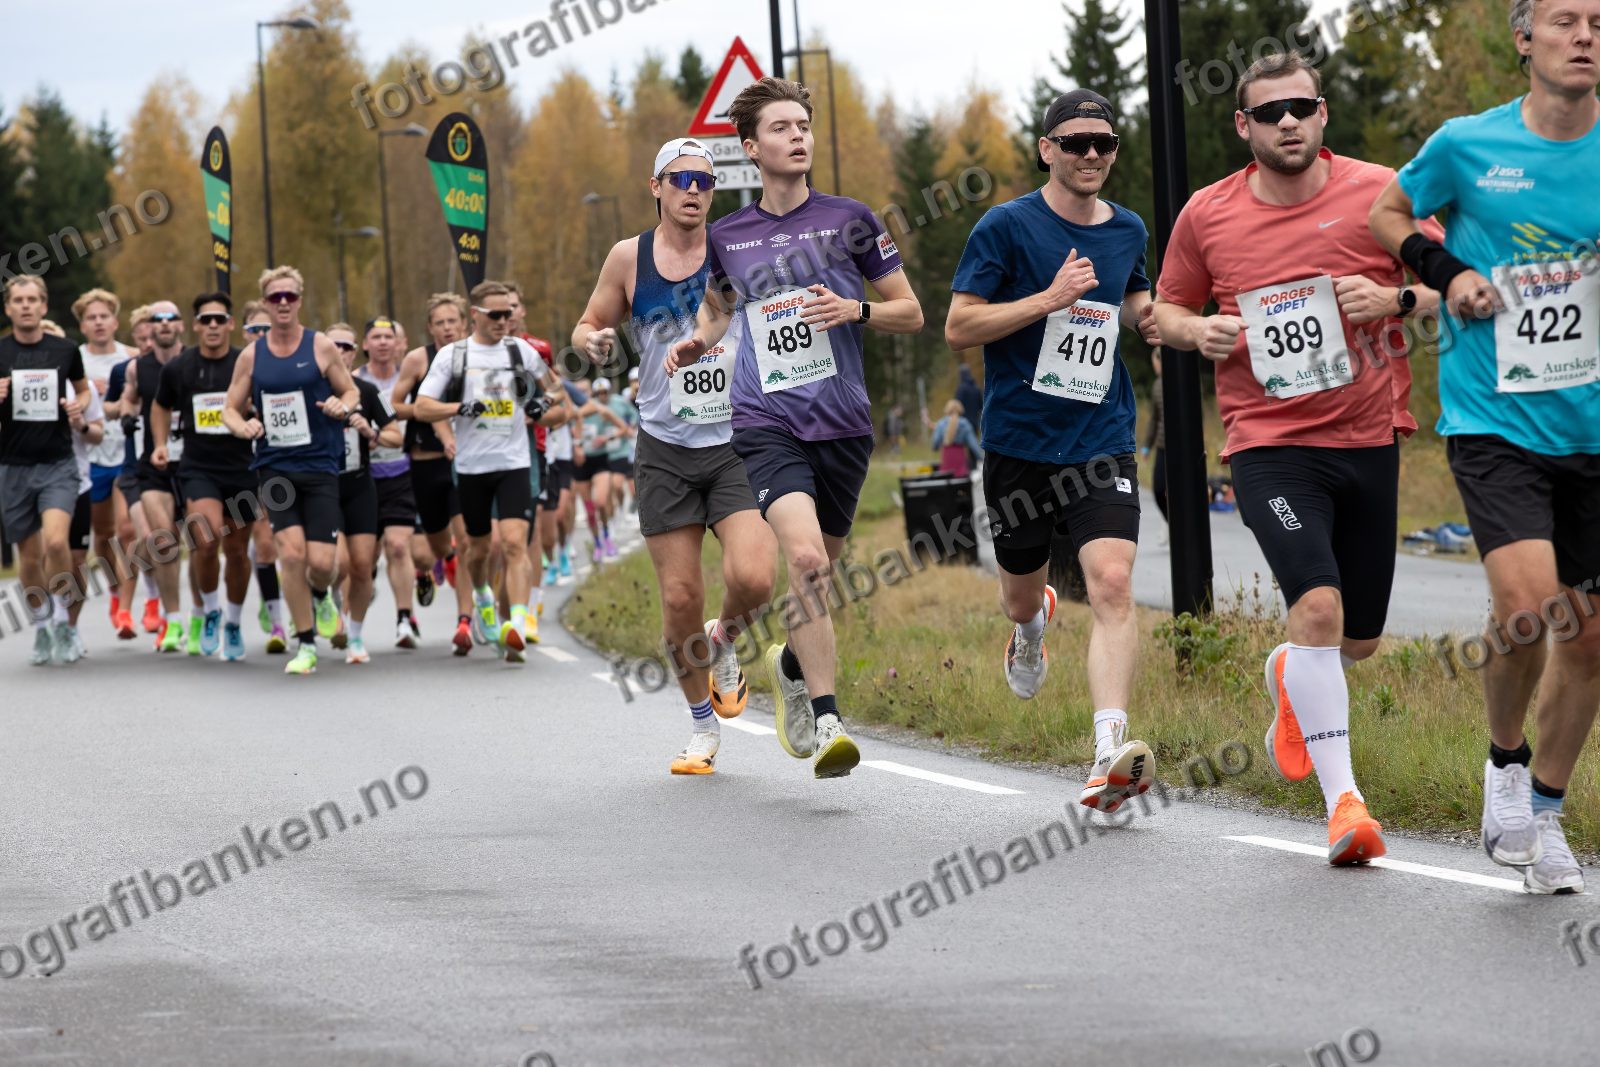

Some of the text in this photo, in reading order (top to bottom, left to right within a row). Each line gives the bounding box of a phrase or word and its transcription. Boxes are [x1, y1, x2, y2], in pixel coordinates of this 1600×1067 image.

[1519, 270, 1582, 285] NORGES
[1260, 286, 1316, 306] NORGES
[1523, 282, 1572, 297] LØPET
[761, 296, 804, 314] NORGES
[766, 306, 799, 322] LØPET
[1069, 306, 1111, 321] NORGES
[1266, 297, 1308, 316] LØPET
[1069, 316, 1106, 328] LØPET
[1517, 304, 1582, 344] 422
[768, 321, 812, 355] 489
[1264, 315, 1323, 358] 389
[1057, 332, 1106, 366] 410
[791, 358, 833, 375] Aurskog
[1294, 361, 1348, 381] Aurskog
[1543, 357, 1597, 374] Aurskog
[684, 368, 726, 394] 880
[22, 387, 49, 402] 818
[270, 411, 298, 427] 384
[1268, 496, 1303, 530] 2XU
